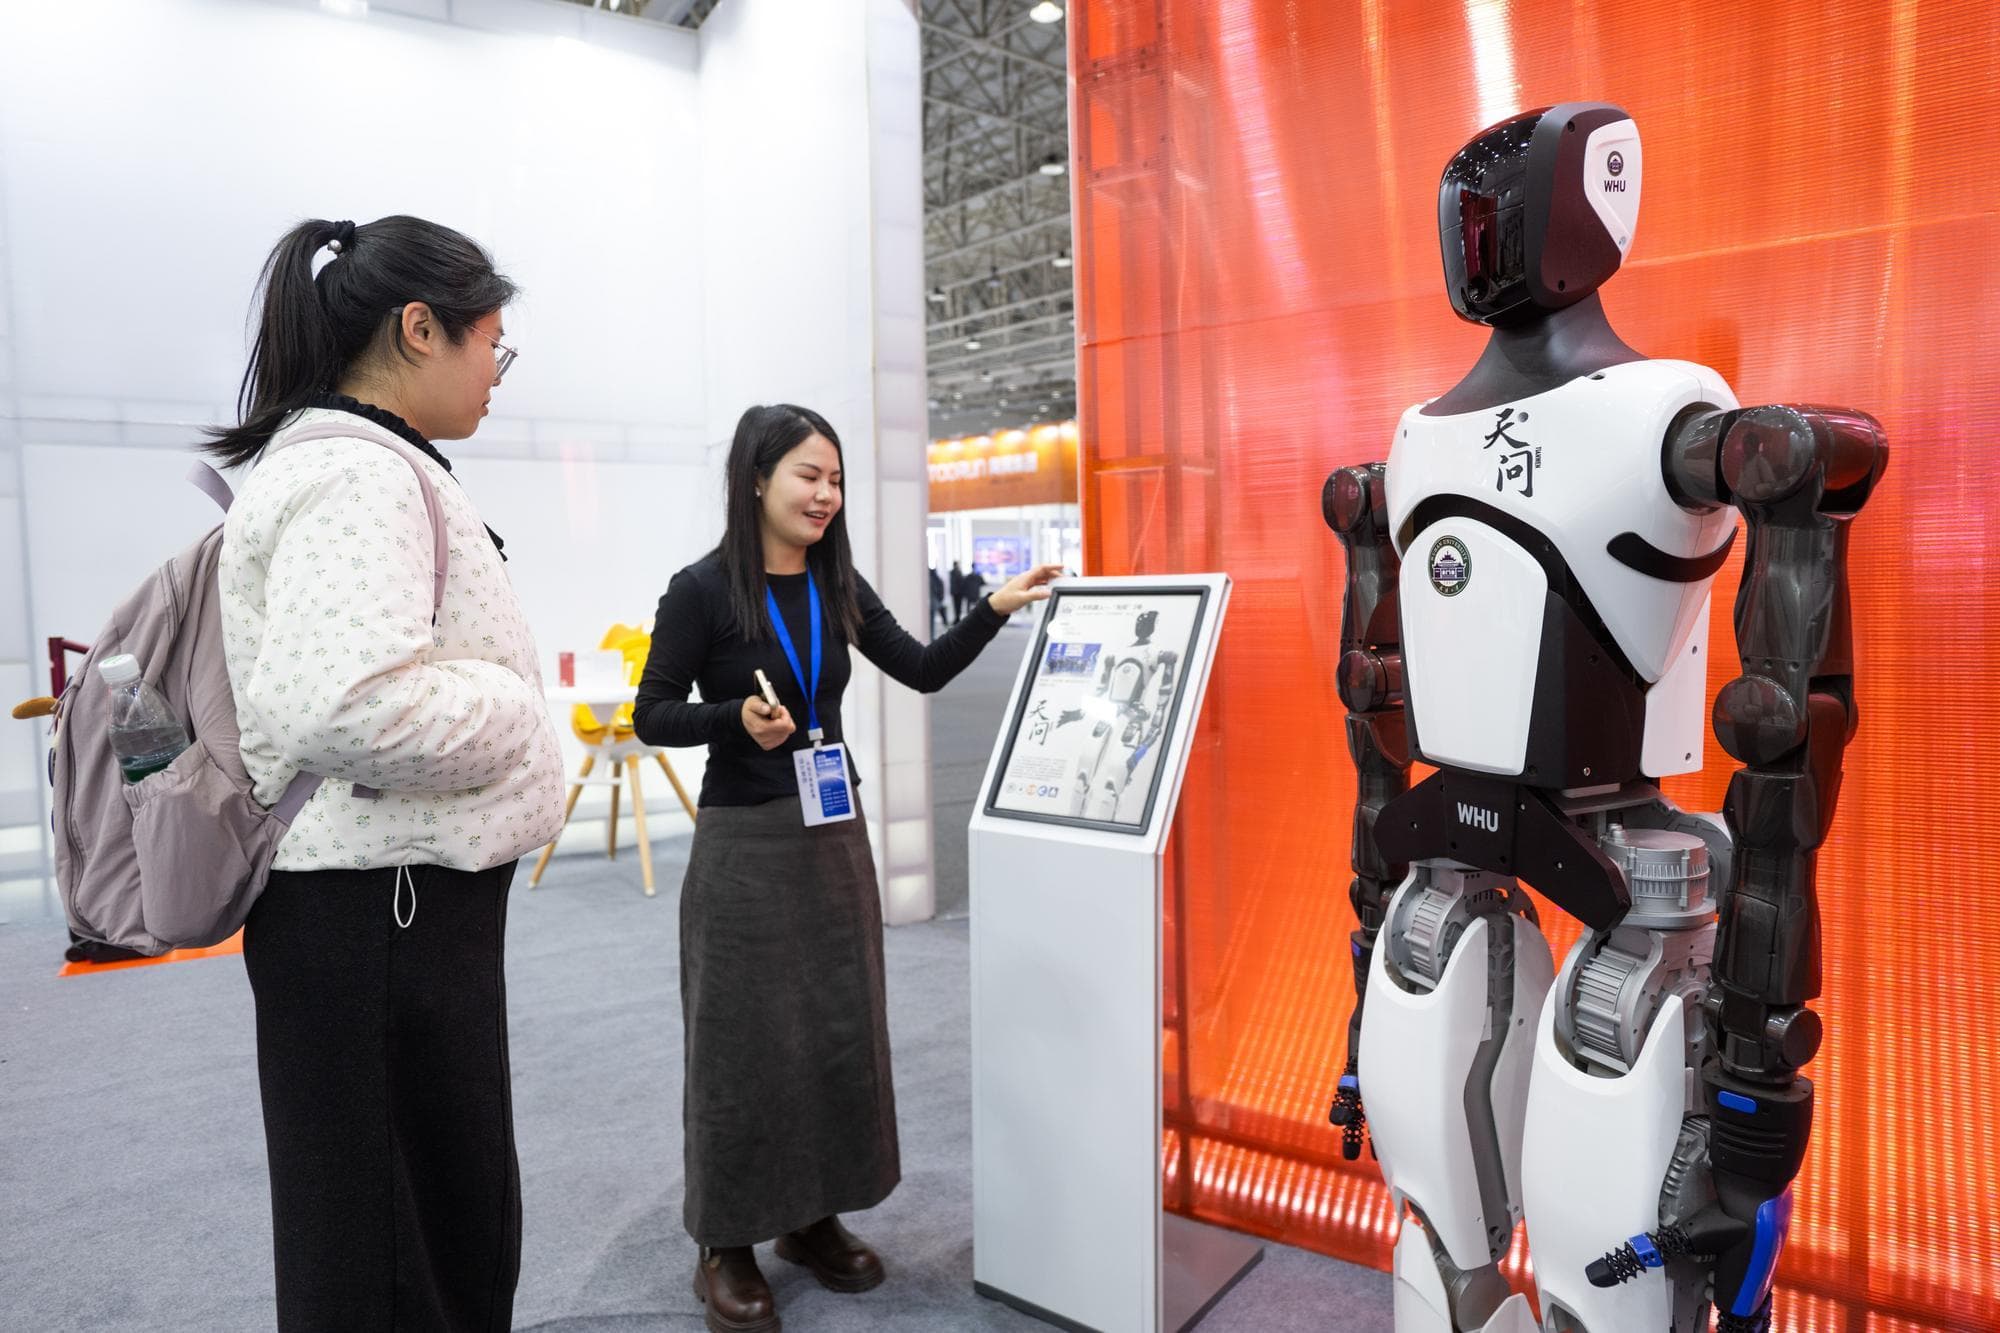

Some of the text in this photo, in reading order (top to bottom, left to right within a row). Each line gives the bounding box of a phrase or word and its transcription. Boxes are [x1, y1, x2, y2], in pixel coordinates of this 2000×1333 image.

[1604, 180, 1626, 192] WHU
[1483, 408, 1533, 498] 天问
[1027, 699, 1049, 746] 天问
[1457, 801, 1498, 832] WHU
